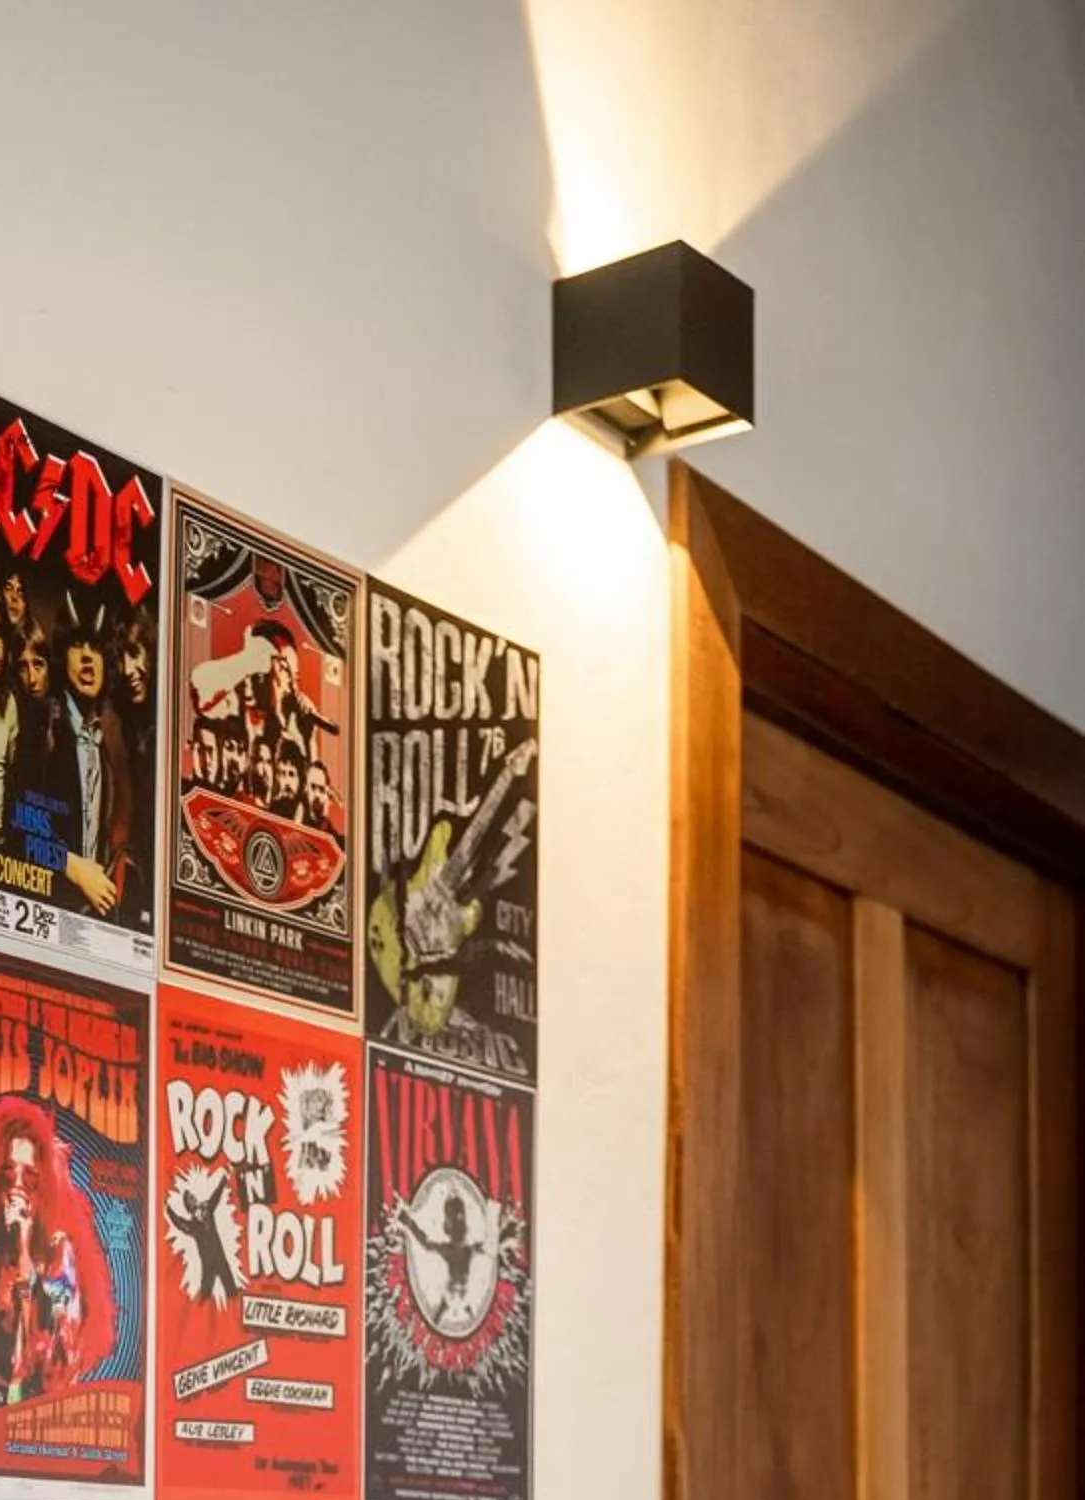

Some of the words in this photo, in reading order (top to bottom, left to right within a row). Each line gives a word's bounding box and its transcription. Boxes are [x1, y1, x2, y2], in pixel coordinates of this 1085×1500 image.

[371, 728, 480, 874] ROLL
[15, 900, 34, 935] 2
[223, 910, 265, 940] LINKIN
[270, 923, 303, 951] PARK
[167, 1079, 275, 1166] ROCK
[245, 1169, 265, 1204] N
[248, 1203, 345, 1286] ROLL
[243, 1300, 282, 1324] LITTLE
[285, 1306, 340, 1330] RICHARD
[178, 1366, 208, 1395] GENE
[212, 1343, 261, 1380] VINCENT
[250, 1380, 280, 1398] EDDIE
